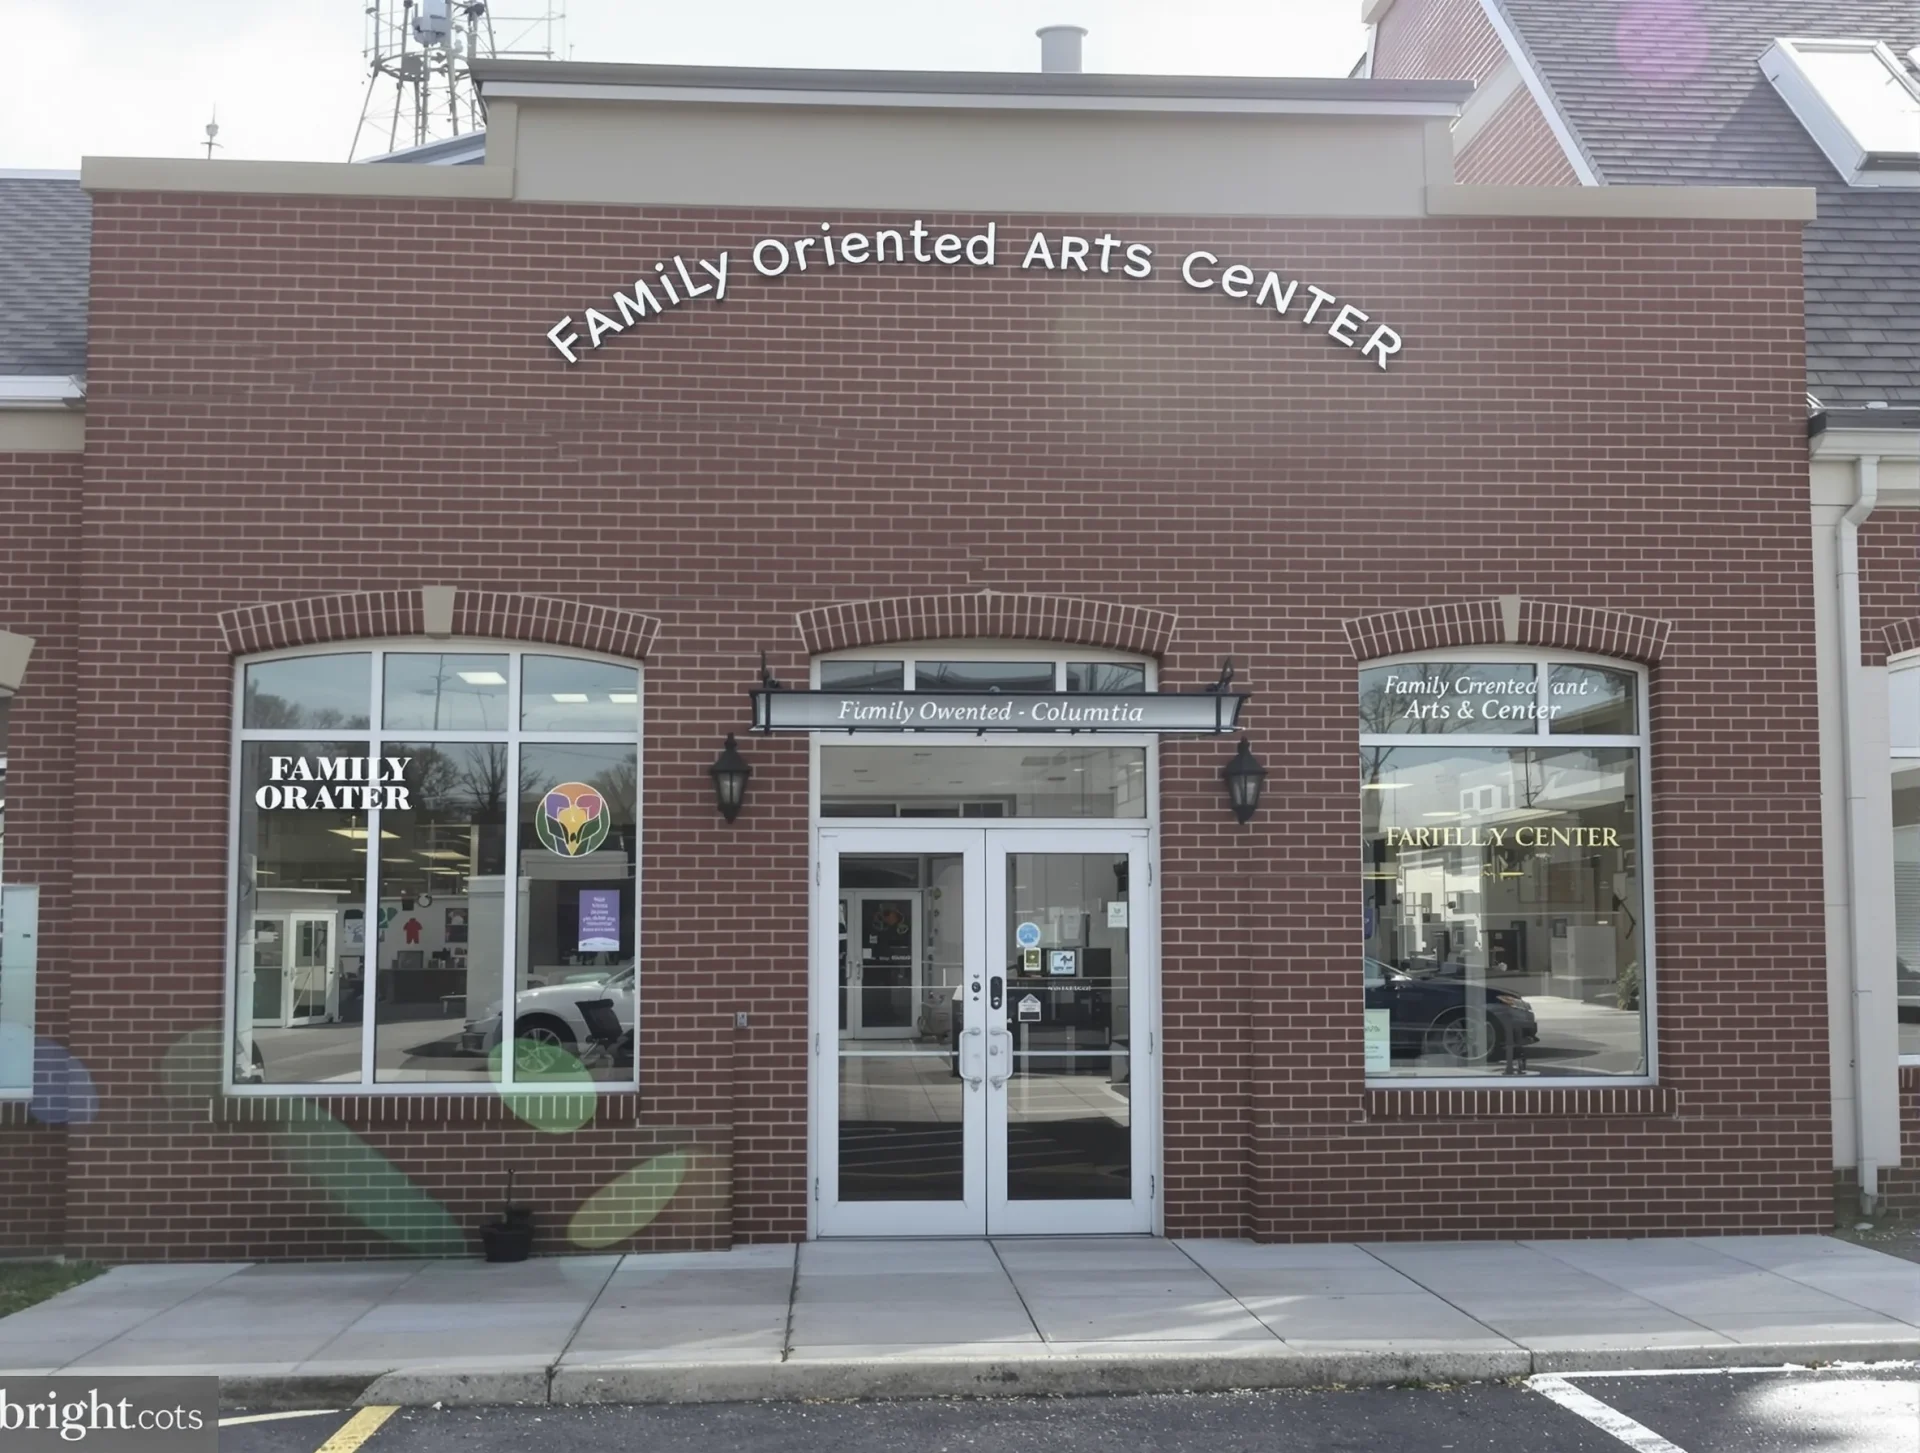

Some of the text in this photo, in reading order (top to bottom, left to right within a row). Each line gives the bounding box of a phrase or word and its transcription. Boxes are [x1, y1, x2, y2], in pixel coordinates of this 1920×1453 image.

[1384, 675, 1450, 699] Family
[1402, 699, 1562, 720] Arts & Center
[269, 756, 412, 781] FAMILY
[255, 785, 412, 810] ORATER
[1515, 826, 1620, 847] CENTER
